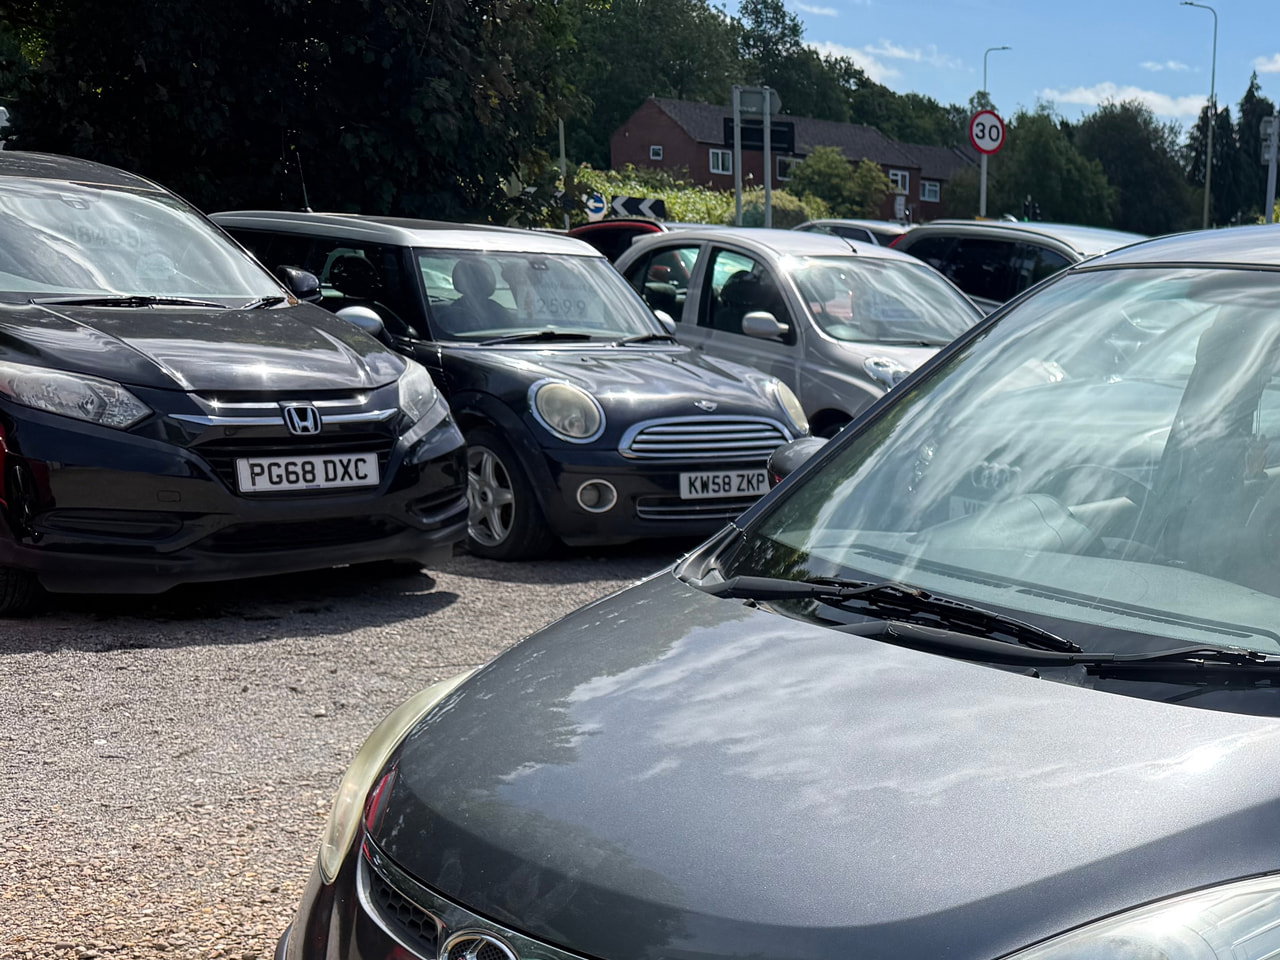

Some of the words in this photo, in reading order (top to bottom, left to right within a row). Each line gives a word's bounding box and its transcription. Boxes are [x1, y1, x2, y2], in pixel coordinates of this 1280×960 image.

[975, 122, 1000, 142] 30
[250, 461, 316, 486] PG68
[323, 458, 368, 482] DXC
[688, 475, 731, 495] KW58
[736, 473, 766, 492] ZKP
